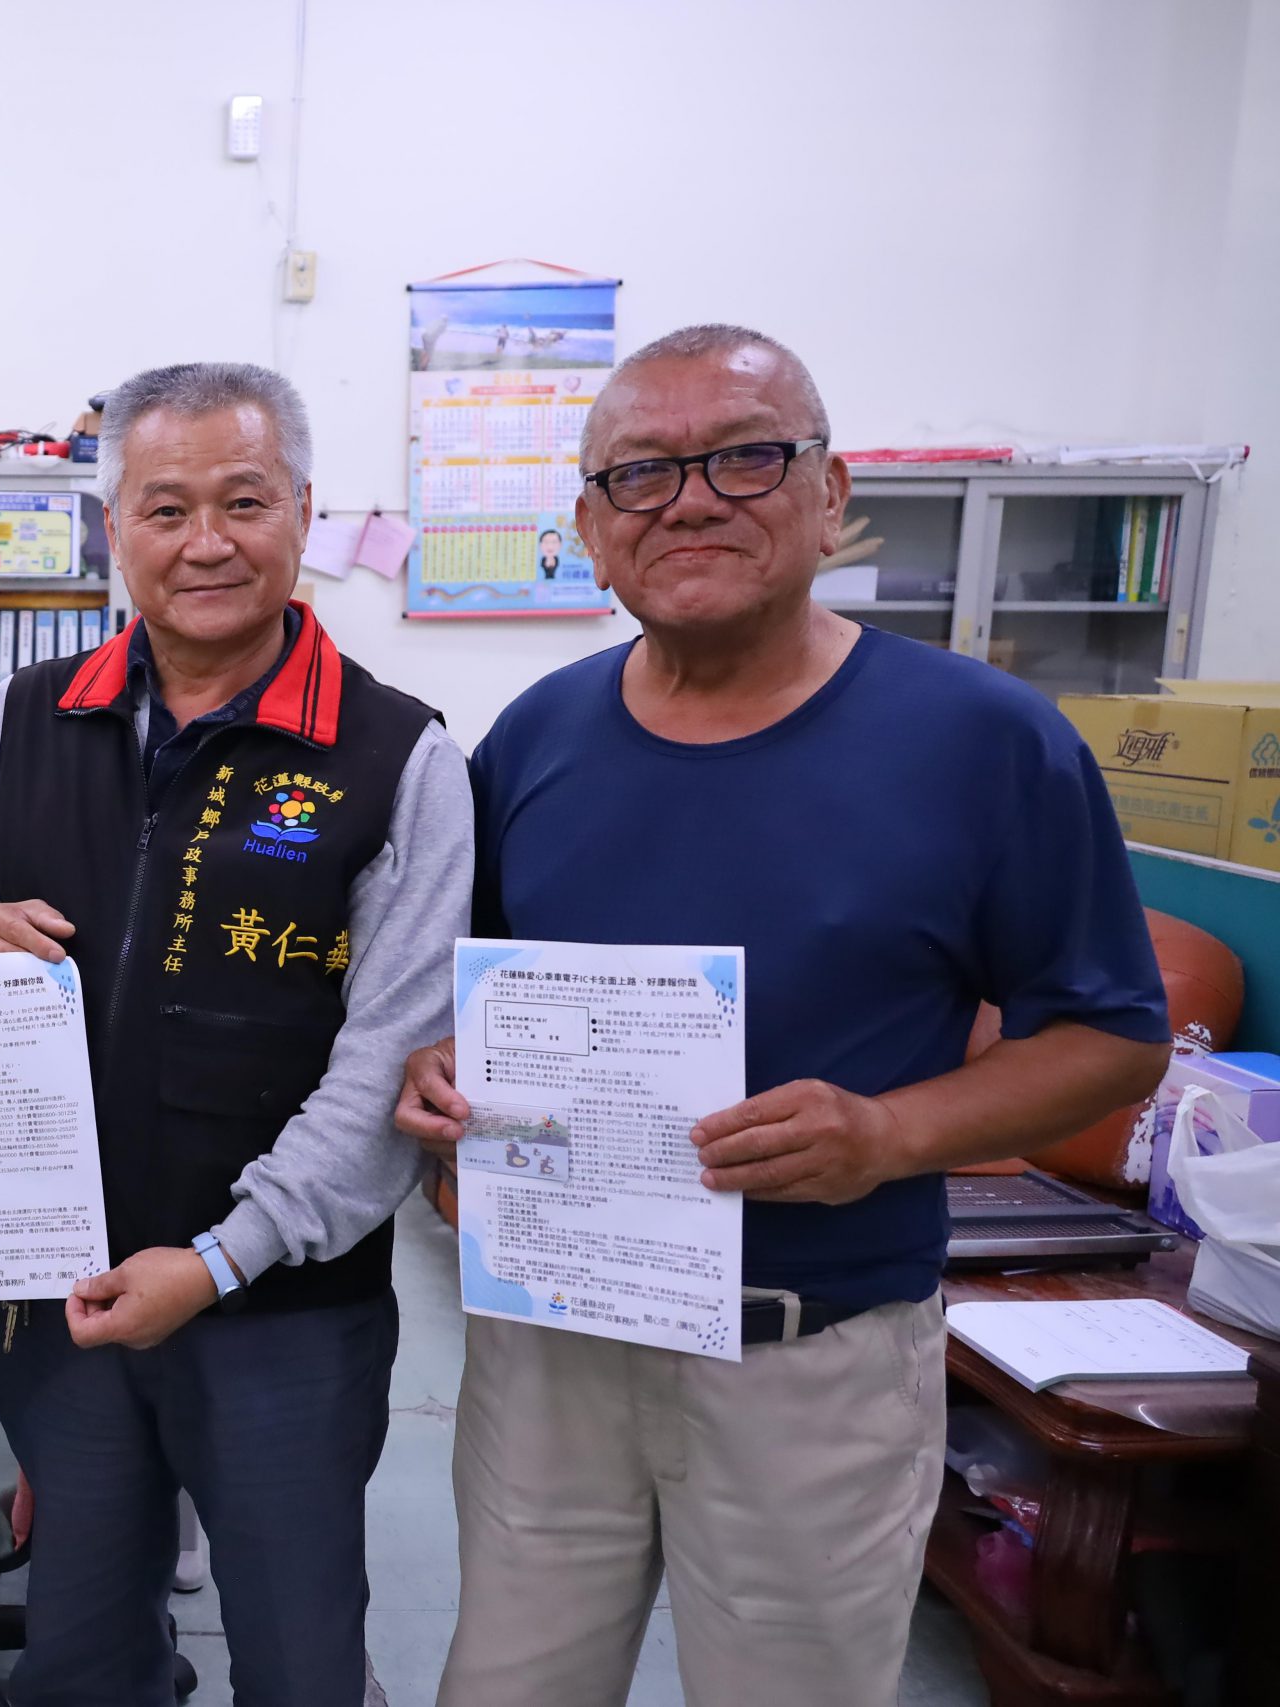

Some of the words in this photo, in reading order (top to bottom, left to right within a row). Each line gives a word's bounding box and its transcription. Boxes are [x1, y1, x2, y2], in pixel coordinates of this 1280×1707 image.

[253, 772, 344, 804] 花蓮縣政府
[243, 838, 307, 863] Hualien
[163, 764, 235, 976] 新城鄉戶政事務所主任
[29, 1272, 52, 1280] 關心您
[571, 1296, 615, 1312] 花蓮縣政府
[571, 1308, 639, 1327] 新城鄉戶政事務所
[643, 1312, 670, 1328] 關心您
